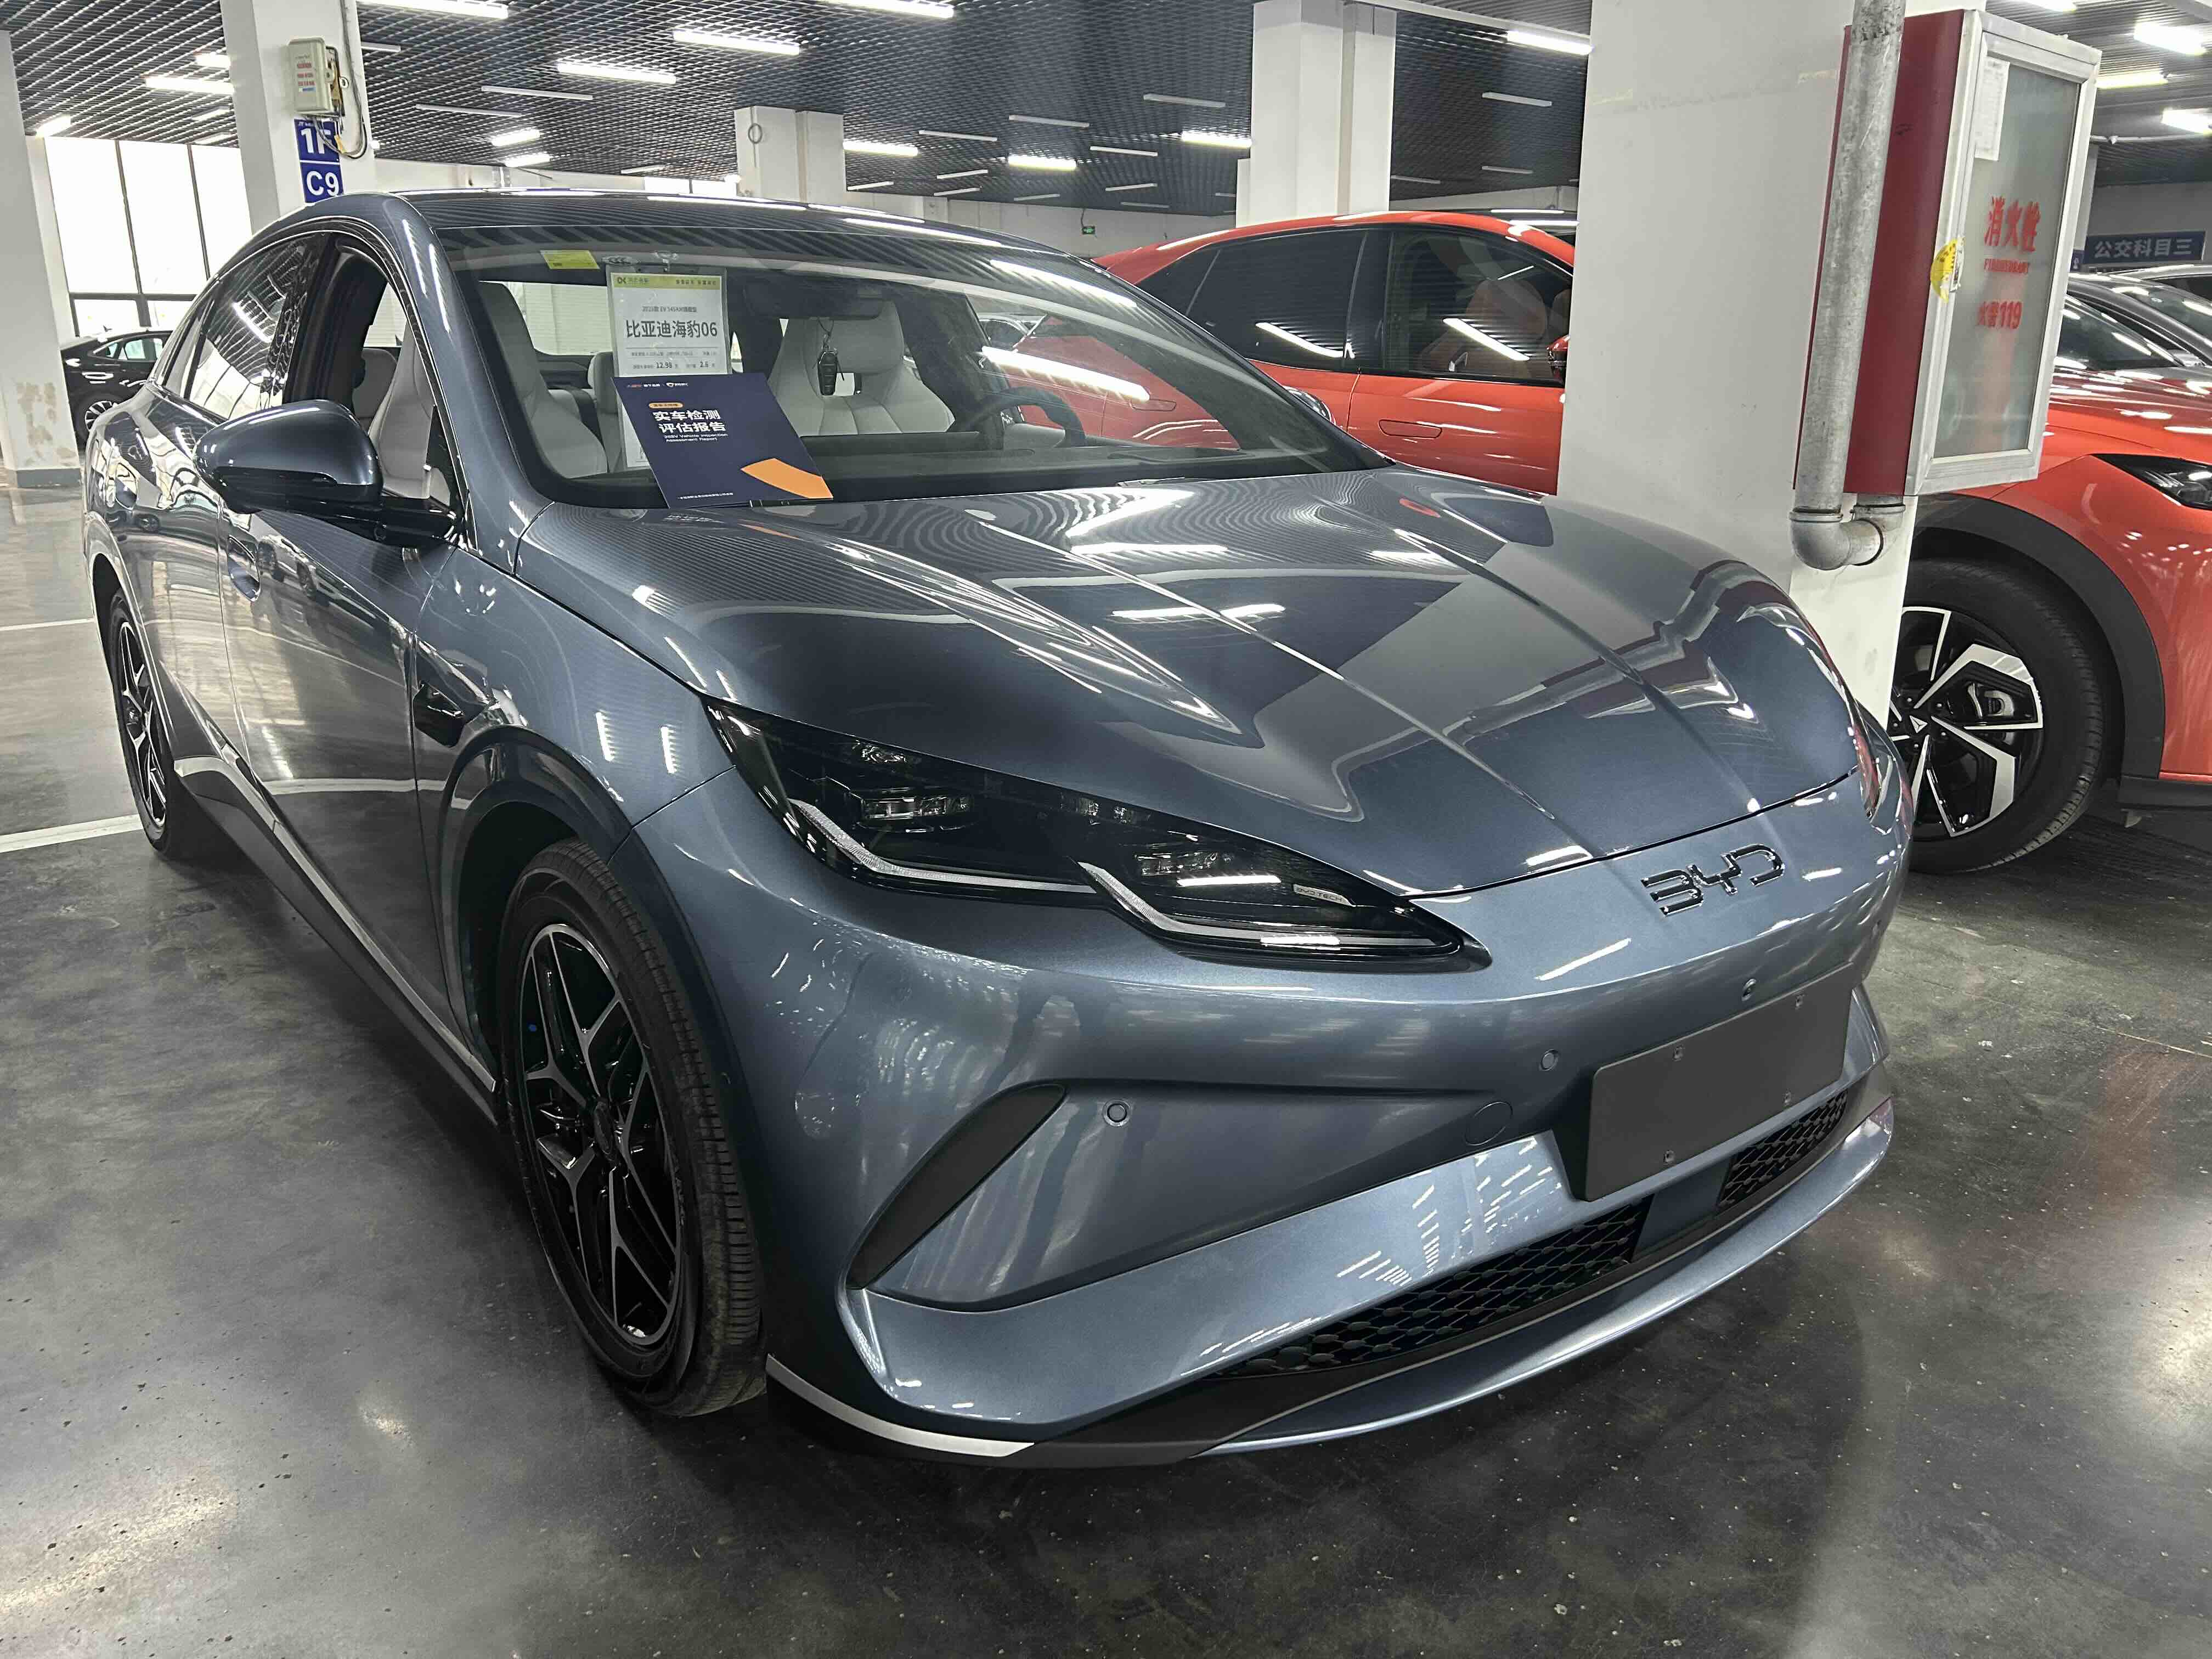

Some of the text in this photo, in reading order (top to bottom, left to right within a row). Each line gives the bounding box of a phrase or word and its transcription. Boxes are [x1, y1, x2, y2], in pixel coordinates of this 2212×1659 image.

[306, 171, 340, 196] C9
[1983, 195, 2041, 252] 消火栓
[2094, 238, 2193, 258] 公交科目三
[626, 320, 718, 338] 比亚迪海豹06
[652, 409, 721, 421] 实车检测
[658, 422, 726, 433] 评估报告
[1640, 843, 1785, 917] BYD
